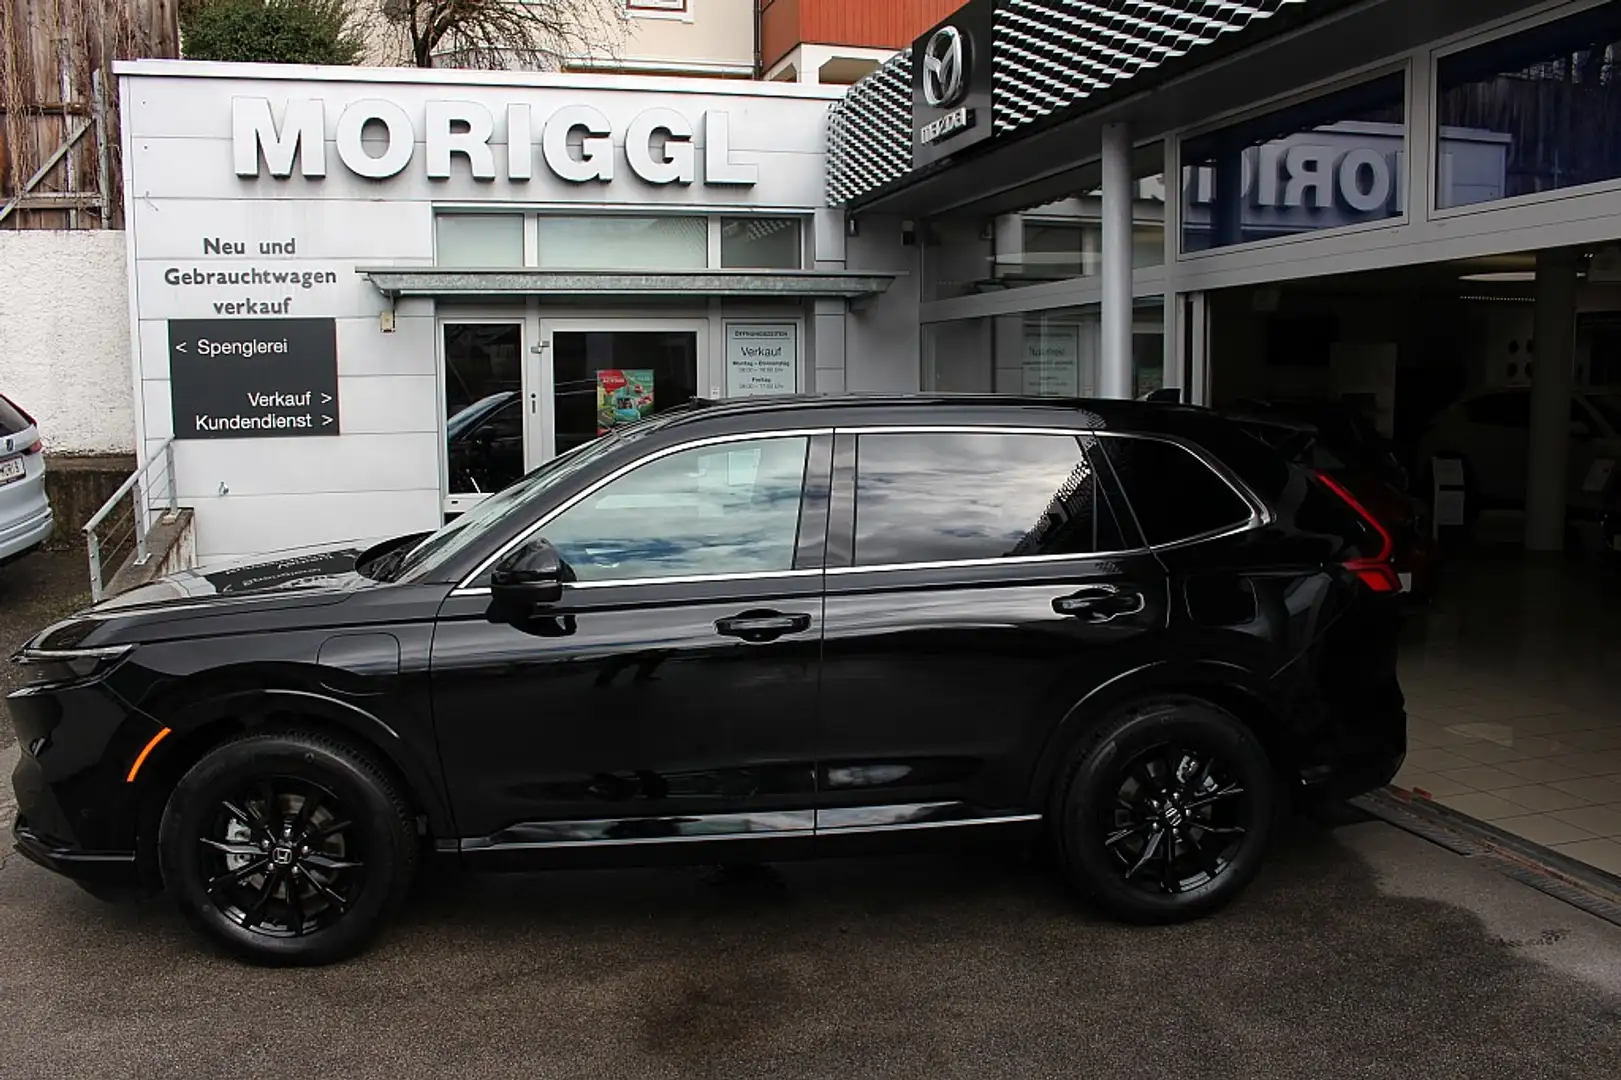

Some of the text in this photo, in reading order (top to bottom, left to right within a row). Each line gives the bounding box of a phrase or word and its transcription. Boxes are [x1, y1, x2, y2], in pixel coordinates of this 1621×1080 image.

[231, 97, 758, 187] MORIGGL
[203, 237, 296, 254] Neu und
[164, 268, 337, 288] Gebrauchtwagen
[213, 298, 292, 315] verkauf
[197, 338, 288, 358] Spenglerei
[741, 346, 782, 357] Verkauf
[247, 391, 312, 407] Verkauf
[195, 413, 313, 431] Kundendienst
